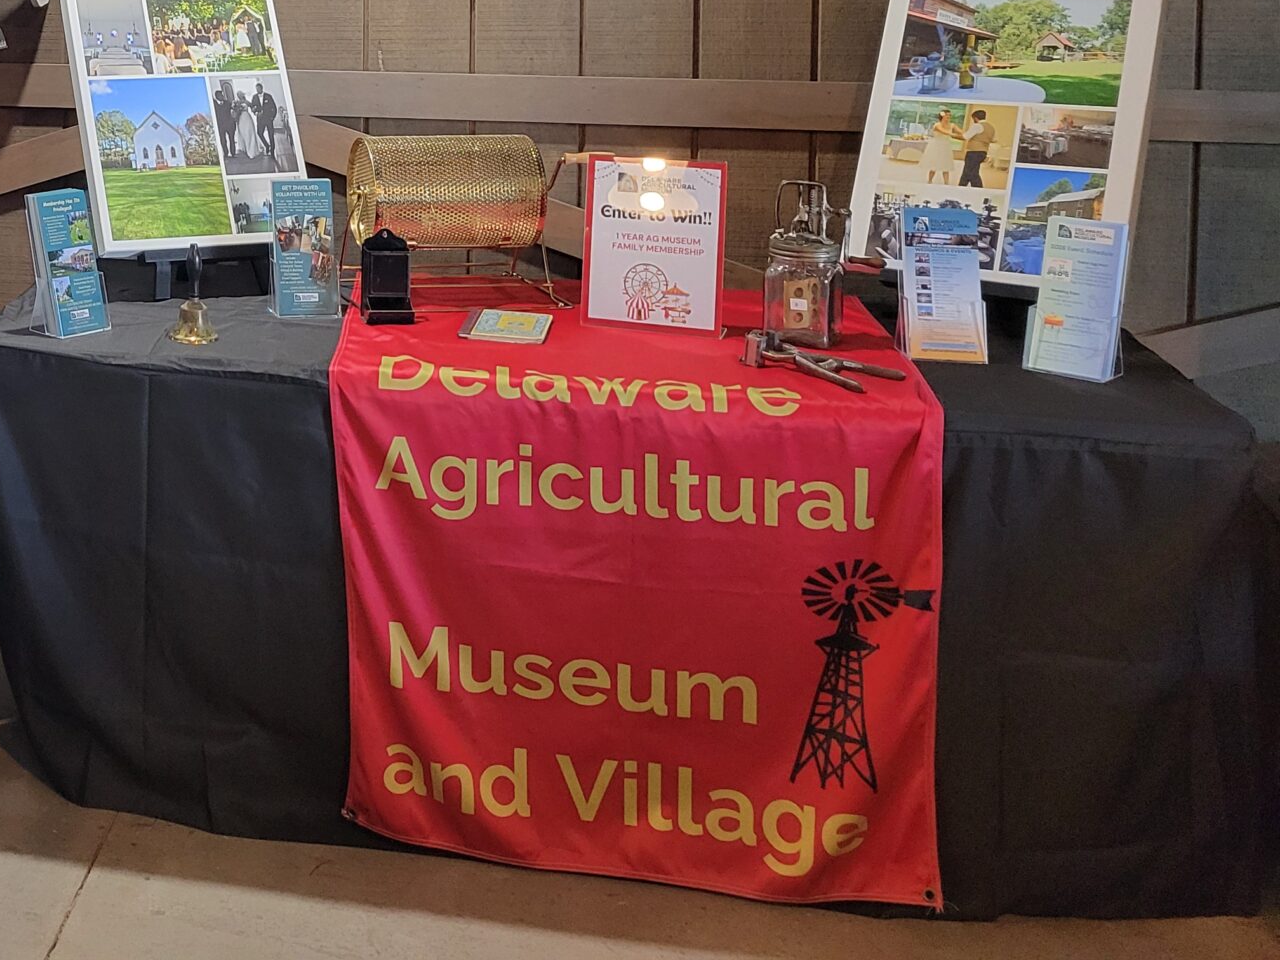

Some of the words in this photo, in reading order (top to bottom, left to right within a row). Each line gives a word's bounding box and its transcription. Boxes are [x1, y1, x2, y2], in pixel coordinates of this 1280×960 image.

[601, 204, 641, 220] Enter
[648, 211, 666, 222] to
[671, 209, 712, 225] Win!!
[616, 232, 619, 240] 1
[621, 233, 644, 241] YEAR
[646, 235, 659, 243] AG
[661, 236, 701, 246] MUSEUM
[612, 242, 644, 252] FAMILY
[646, 245, 704, 257] MEMBERSHIP
[378, 355, 802, 416] Delaware
[375, 436, 876, 533] Agricultural
[387, 621, 759, 724] Museum
[383, 743, 530, 818] and
[556, 754, 869, 877] Village
